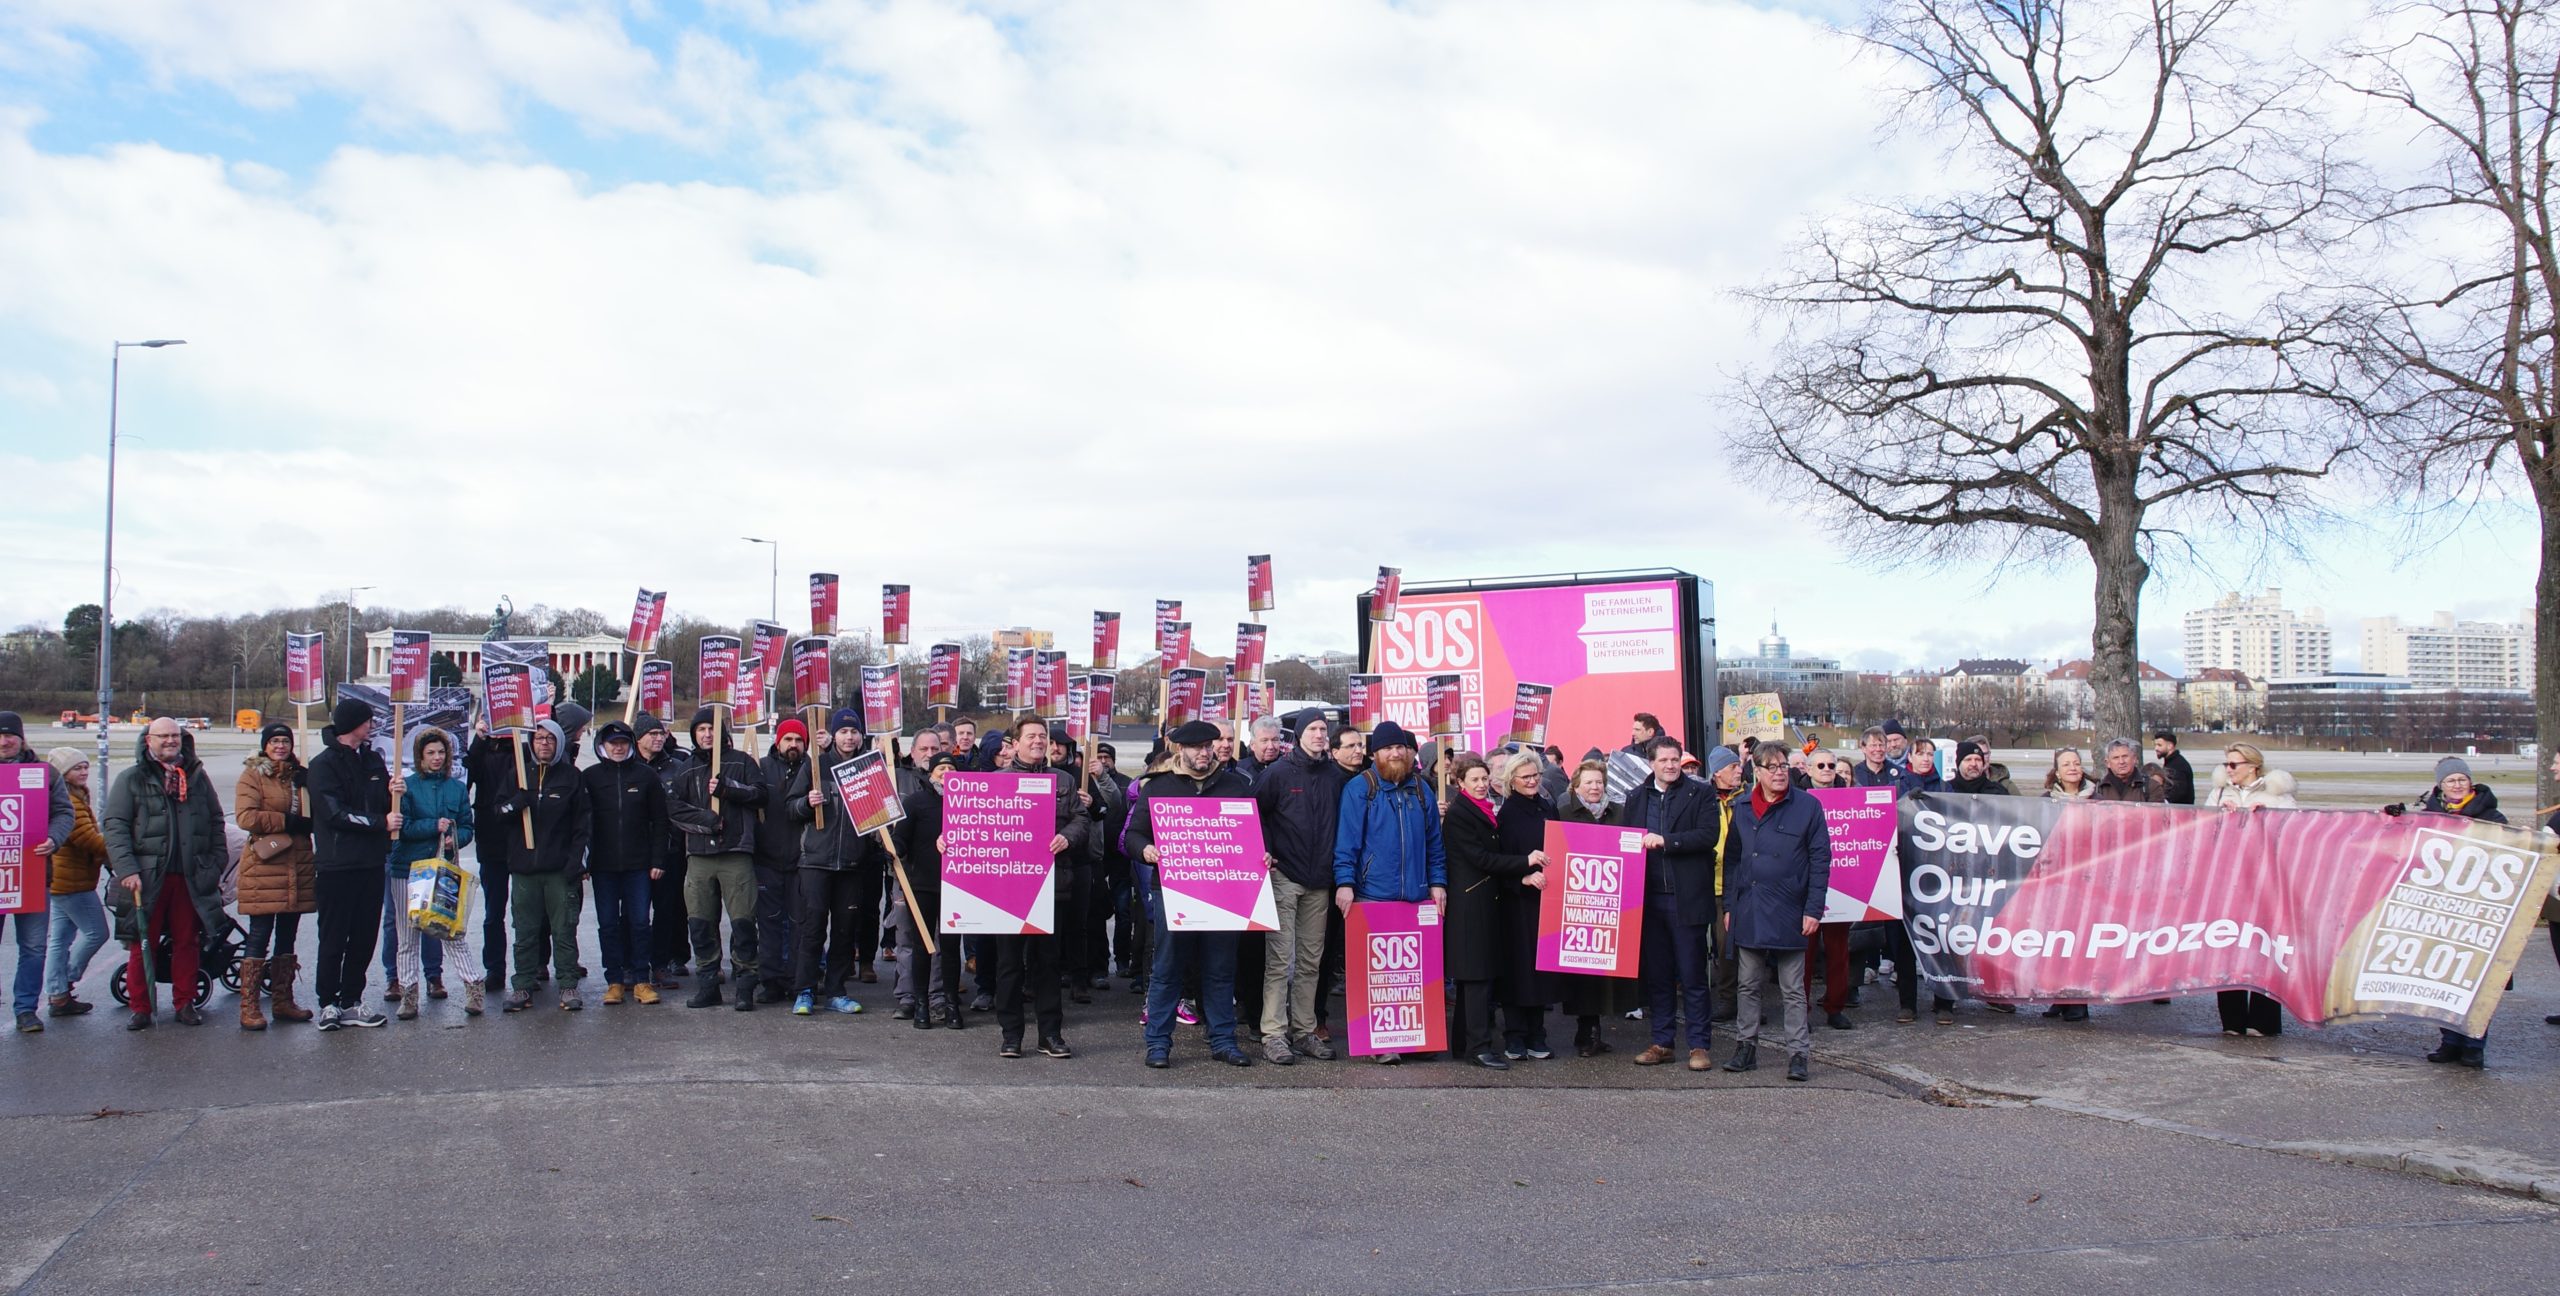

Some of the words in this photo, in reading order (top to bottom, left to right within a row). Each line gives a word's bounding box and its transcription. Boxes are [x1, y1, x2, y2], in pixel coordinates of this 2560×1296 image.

[1609, 597, 1651, 606] FAMILIEN
[1592, 606, 1663, 616] UNTERNEHMER
[1386, 608, 1474, 670] SOS
[704, 641, 725, 650] Hohe
[703, 651, 734, 659] Steuern
[1594, 648, 1664, 657] UNTERNEHMER
[703, 660, 729, 669] kosten
[488, 667, 510, 675] Hohe
[703, 670, 723, 679] Jobs.
[864, 671, 884, 679] Hohe
[489, 675, 522, 685] Energie-
[865, 680, 895, 688] Steuern
[1384, 674, 1478, 696] WIRTSTS
[490, 683, 517, 692] kosten
[491, 691, 518, 701] kosten
[866, 690, 891, 698] kosten
[492, 700, 514, 709] Jobs.
[1514, 712, 1530, 720] Jobs.
[837, 766, 856, 777] Eure
[841, 765, 882, 785] Bürokratie
[844, 779, 870, 793] kostet
[948, 778, 988, 792] Ohne
[848, 790, 869, 801] Jobs.
[948, 795, 1038, 809] Wirtschafts-
[1154, 802, 1193, 814] Ohne
[947, 813, 1024, 825] wachstum
[1824, 807, 1886, 820] irtschafts-
[1155, 816, 1243, 828] Wirtschafts-
[994, 828, 1032, 842] keine
[1158, 831, 1232, 840] wachstum
[1912, 810, 2041, 859] Save
[946, 845, 1009, 857] sicheren
[1205, 843, 1243, 854] keine
[1830, 839, 1887, 851] rtschafts-
[1162, 856, 1223, 867] sicheren
[946, 861, 1047, 877] Arbeitsplätze.
[2410, 838, 2524, 900] SOS
[1164, 869, 1263, 883] Arbeitsplätze.
[1569, 858, 1618, 893] SOS
[1910, 864, 2006, 907] Our
[1567, 893, 1618, 907] WIRTSCHAFTS
[2396, 887, 2507, 922] WIRTSCHAFTS
[1566, 907, 1617, 925] WARNTAG
[2385, 905, 2496, 948] WARNTAG
[1565, 927, 1615, 953] 29.01.
[1913, 913, 2076, 958] Sieben
[2086, 917, 2295, 974] Prozent
[1371, 936, 1418, 970] SOS
[1563, 956, 1613, 966] #SOSWIRTSCHAFT
[2368, 934, 2474, 988] 29.01.
[1371, 973, 1420, 984] WIRTSCHAFTS
[1371, 987, 1421, 1002] WARNTAG
[2361, 980, 2463, 1006] #SOSWIRTSCHAFT
[1373, 1005, 1422, 1031] 29.01.
[1375, 1035, 1421, 1044] #SOSWIRTSCHAFT
